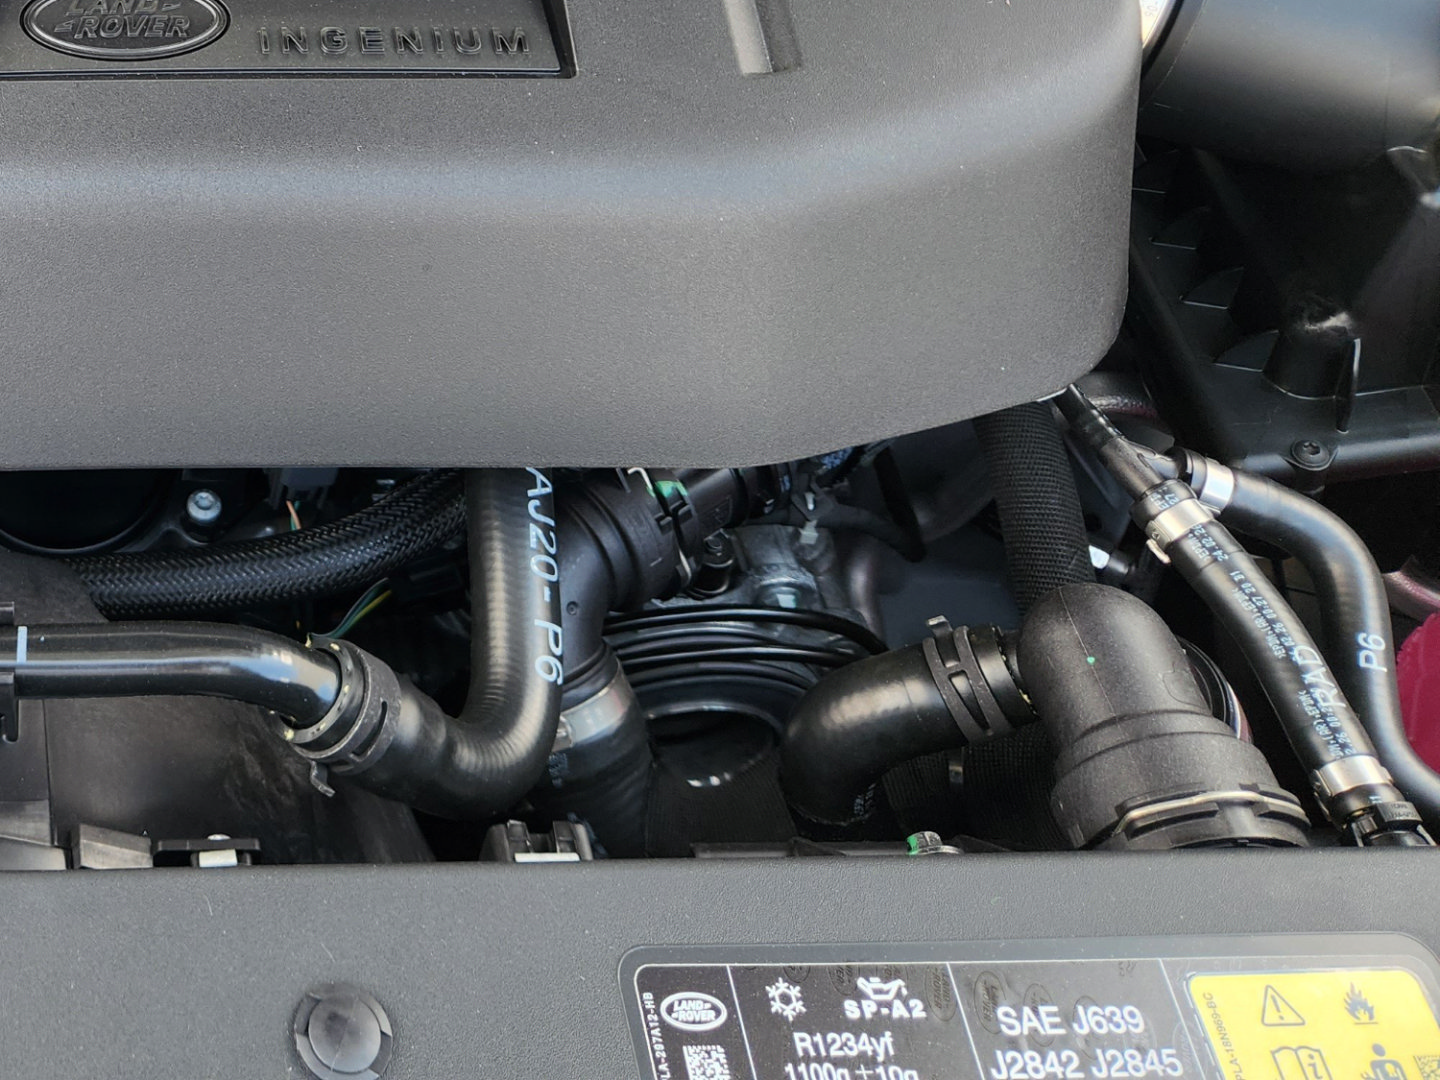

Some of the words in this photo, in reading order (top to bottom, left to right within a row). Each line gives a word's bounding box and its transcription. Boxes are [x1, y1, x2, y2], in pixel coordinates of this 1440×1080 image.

[73, 15, 191, 40] ROVER
[259, 26, 531, 56] INGENIUM
[1357, 632, 1388, 673] P6
[1293, 644, 1346, 708] RAD
[673, 1000, 705, 1011] LAND
[678, 1010, 716, 1022] ROVER
[843, 999, 928, 1020] SP-A2
[996, 1005, 1066, 1036] SAE
[1072, 1004, 1145, 1035] J639
[642, 992, 672, 1080] LA-297A12-HB
[792, 1030, 895, 1062] R1234yf
[990, 1049, 1086, 1080] J2842
[1090, 1048, 1184, 1079] J2845
